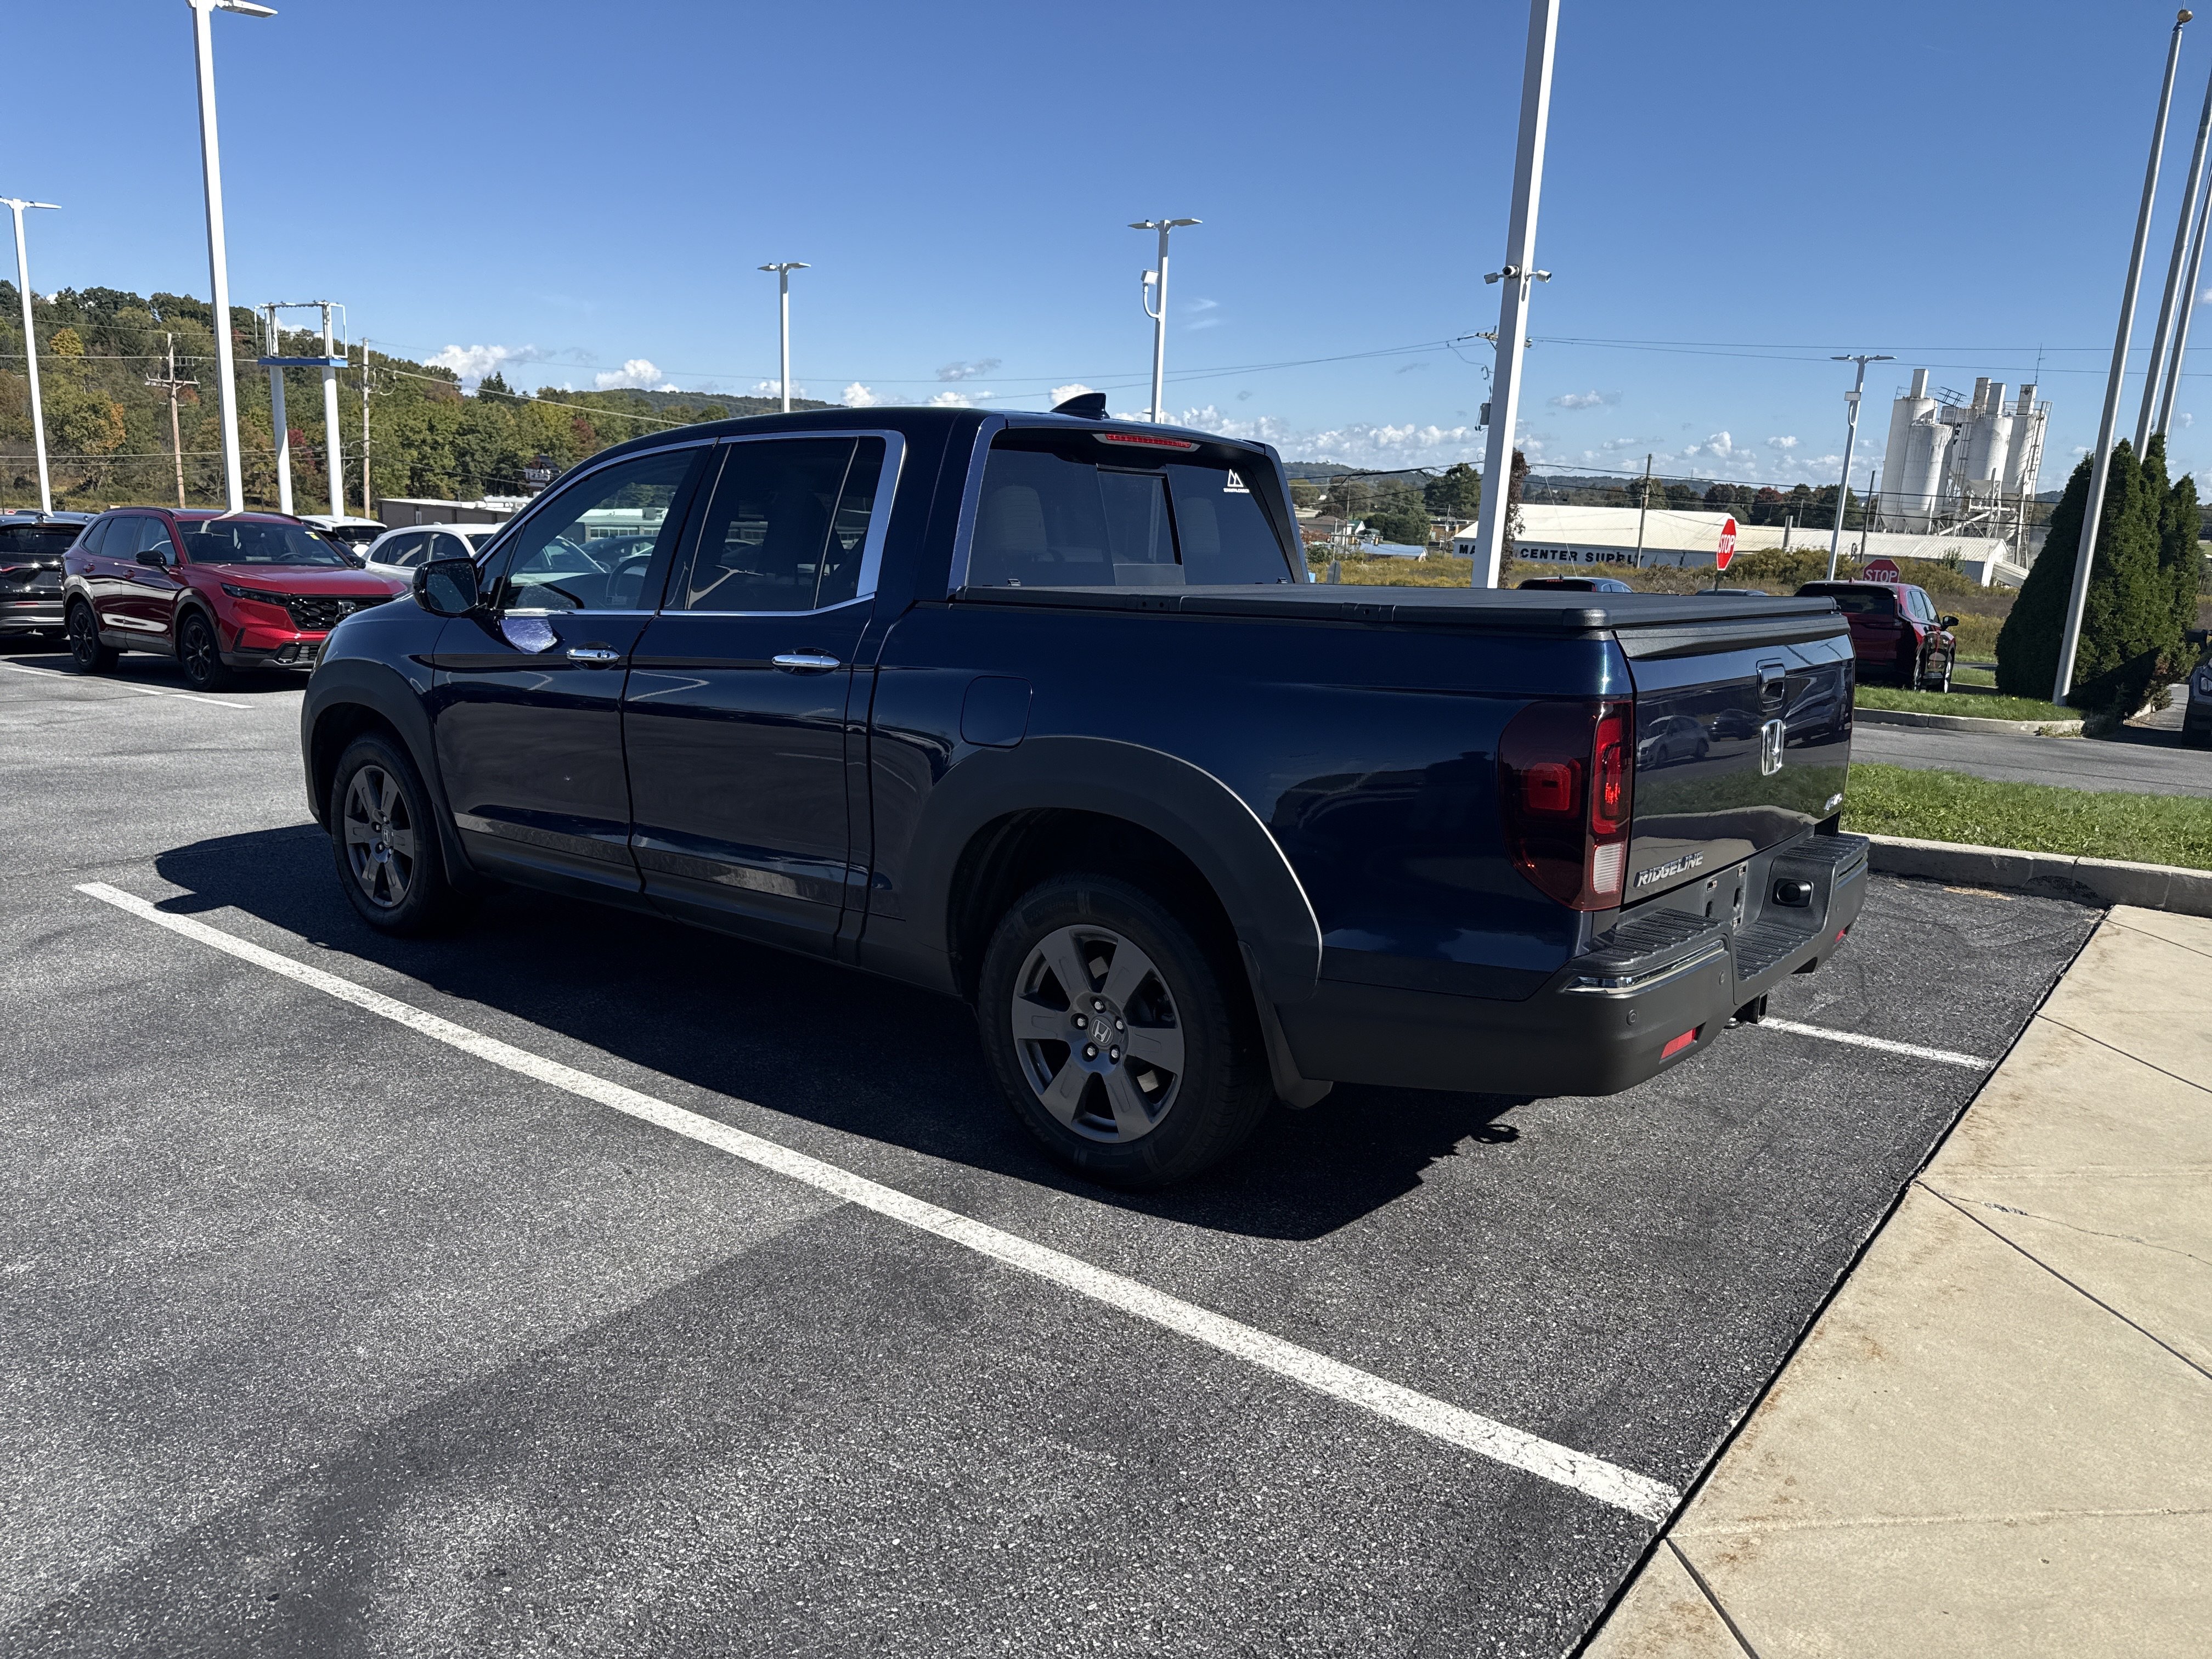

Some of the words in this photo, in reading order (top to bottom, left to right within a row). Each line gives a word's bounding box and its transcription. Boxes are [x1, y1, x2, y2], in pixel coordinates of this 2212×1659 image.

[1718, 534, 1735, 554] STOP
[1520, 548, 1578, 562] CENTER
[1864, 569, 1898, 583] STOP
[1634, 851, 1705, 888] RIDGELINE
